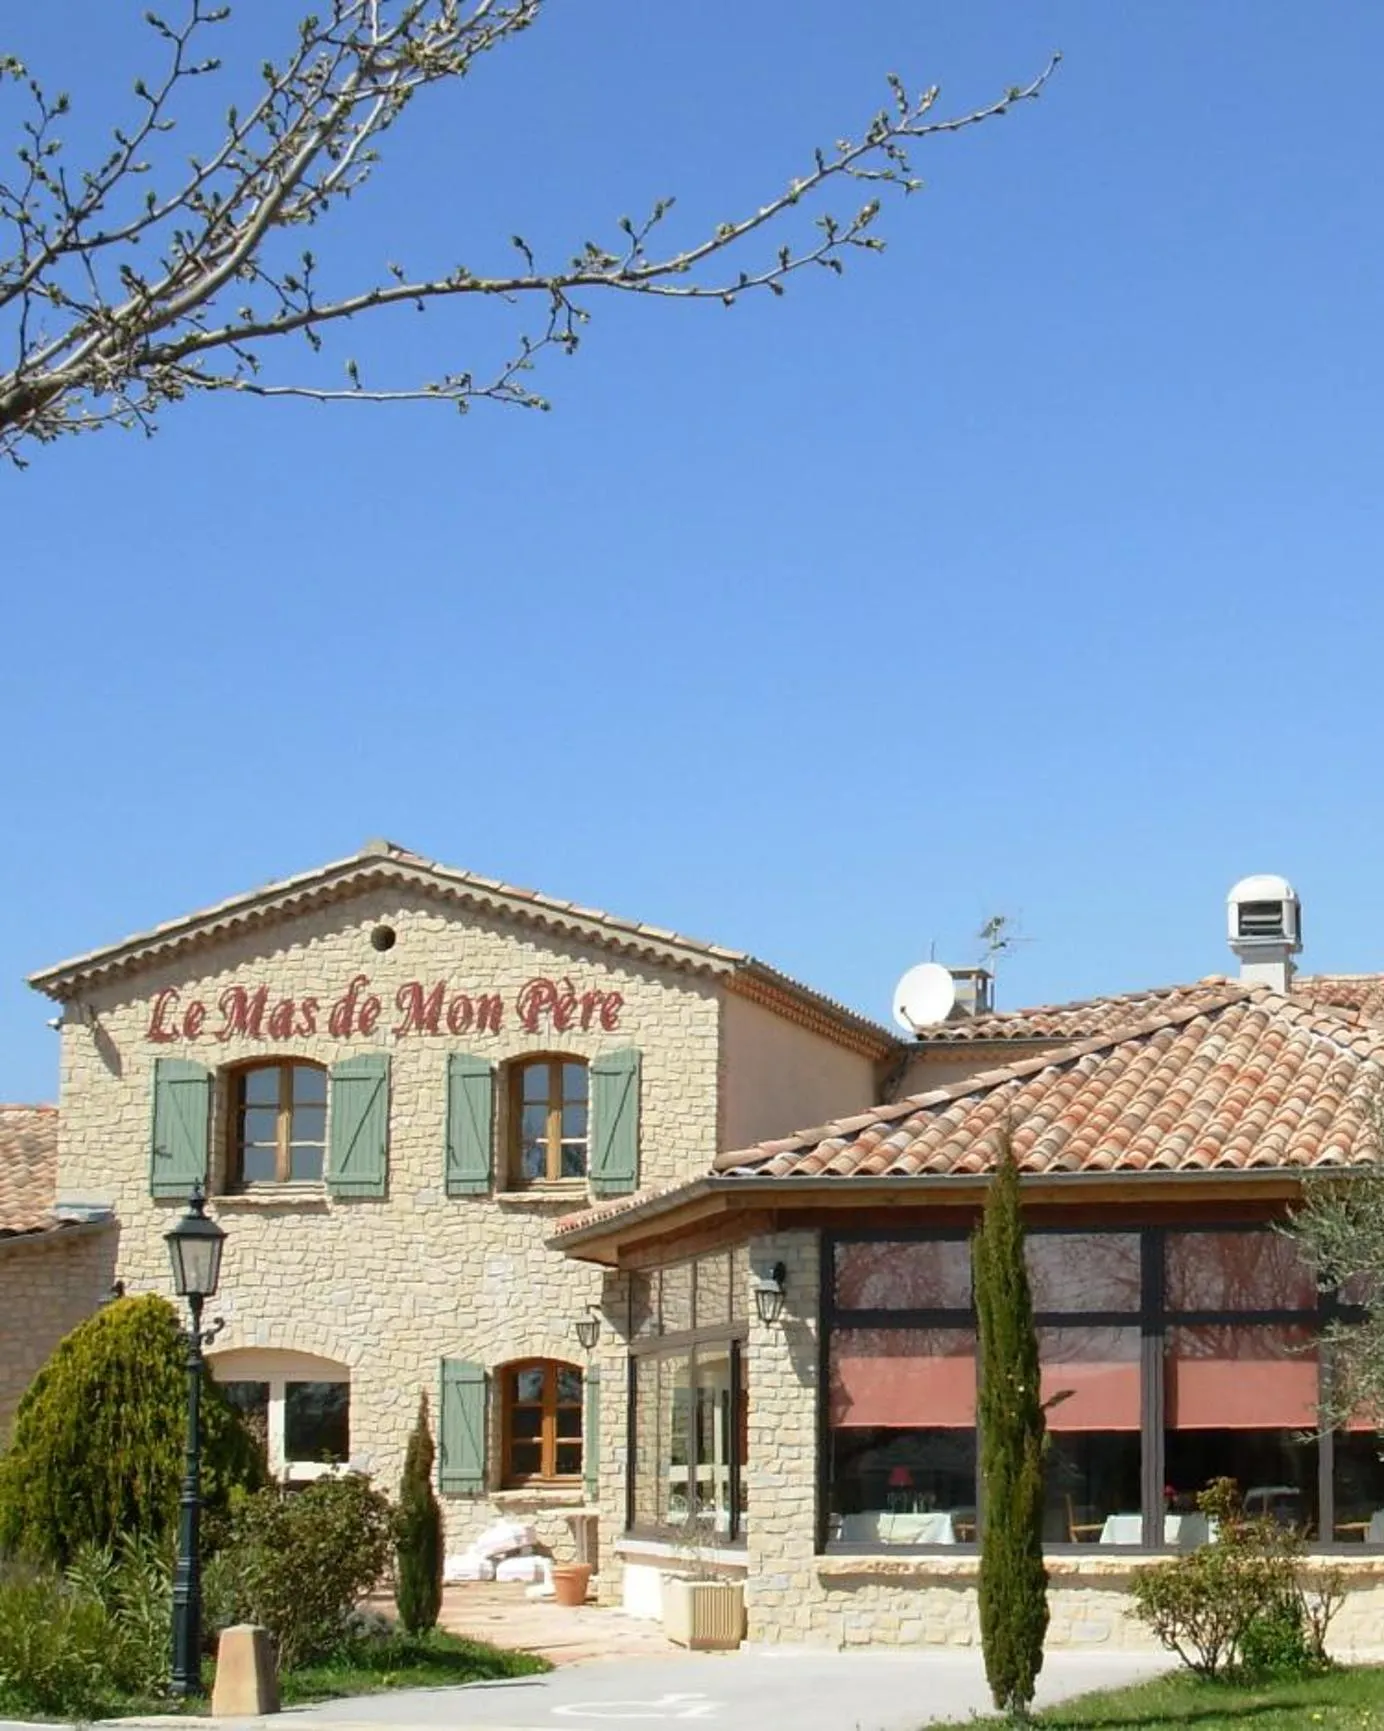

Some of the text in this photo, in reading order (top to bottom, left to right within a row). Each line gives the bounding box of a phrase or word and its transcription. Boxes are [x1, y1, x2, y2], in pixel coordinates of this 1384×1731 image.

[145, 974, 625, 1043] Le Mas de Mon Père
